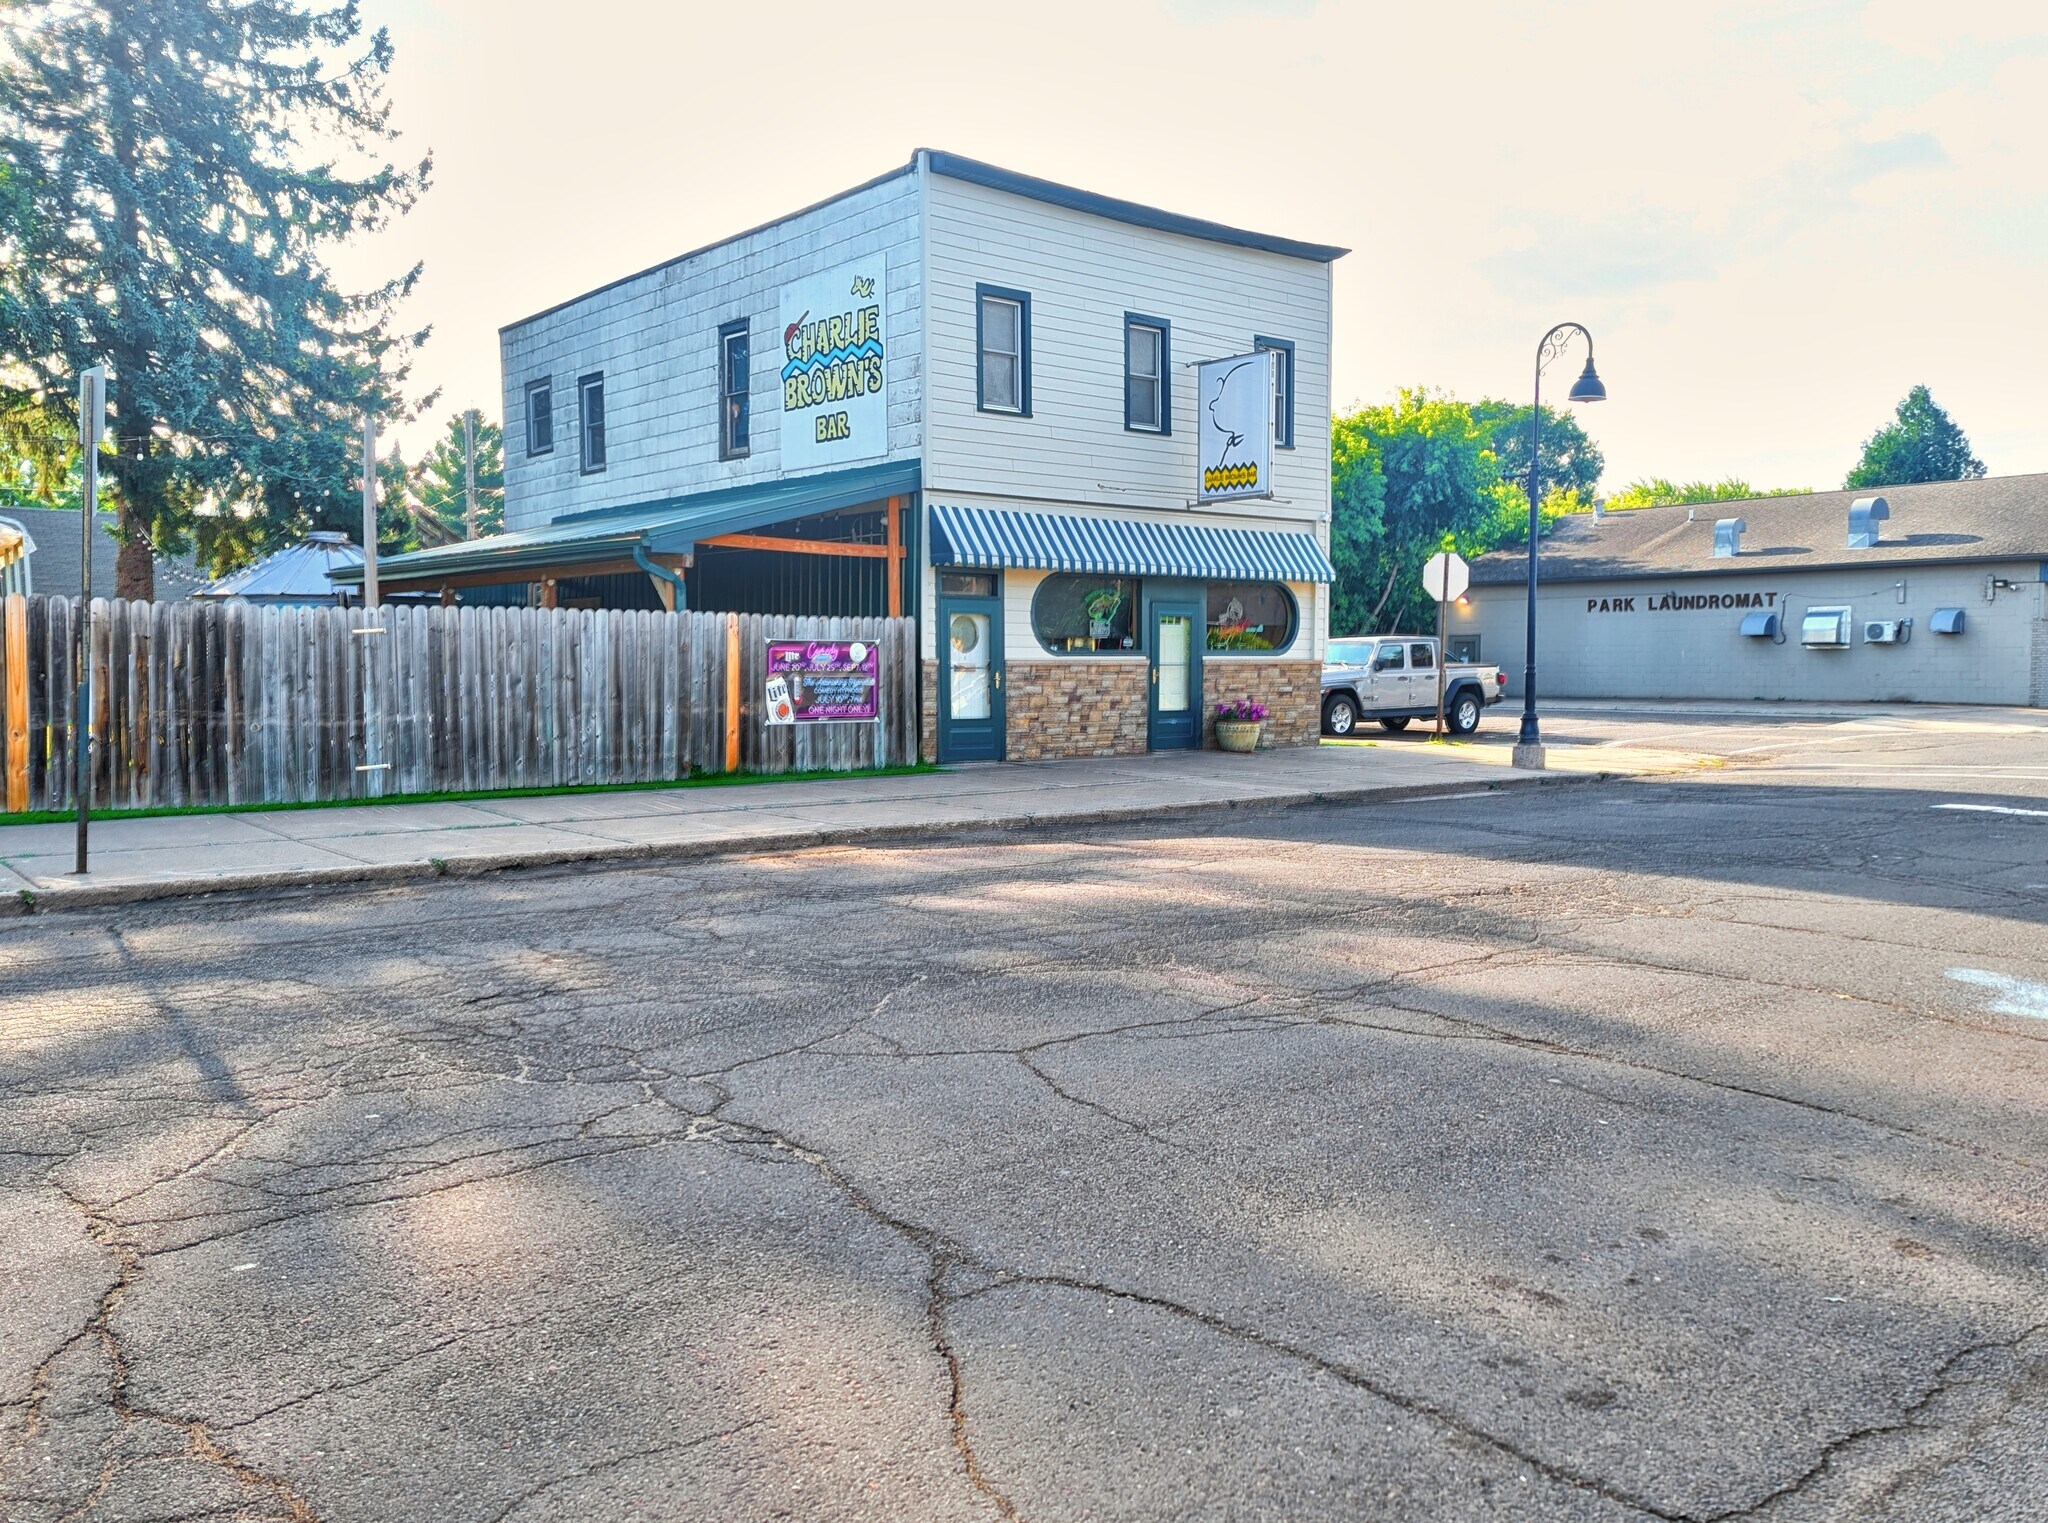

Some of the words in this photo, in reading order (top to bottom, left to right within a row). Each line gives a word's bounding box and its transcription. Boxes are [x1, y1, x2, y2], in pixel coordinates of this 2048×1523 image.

[786, 304, 880, 362] CHARLIE
[784, 355, 883, 412] BROWN'S
[815, 411, 850, 443] BAR
[1587, 597, 1635, 613] PARK
[1648, 592, 1777, 611] LAUNDROMAT
[771, 663, 791, 672] JUNE
[807, 663, 826, 672] JULY
[808, 705, 825, 714] ONE
[825, 704, 847, 714] NIGHT
[815, 694, 835, 703] JULY
